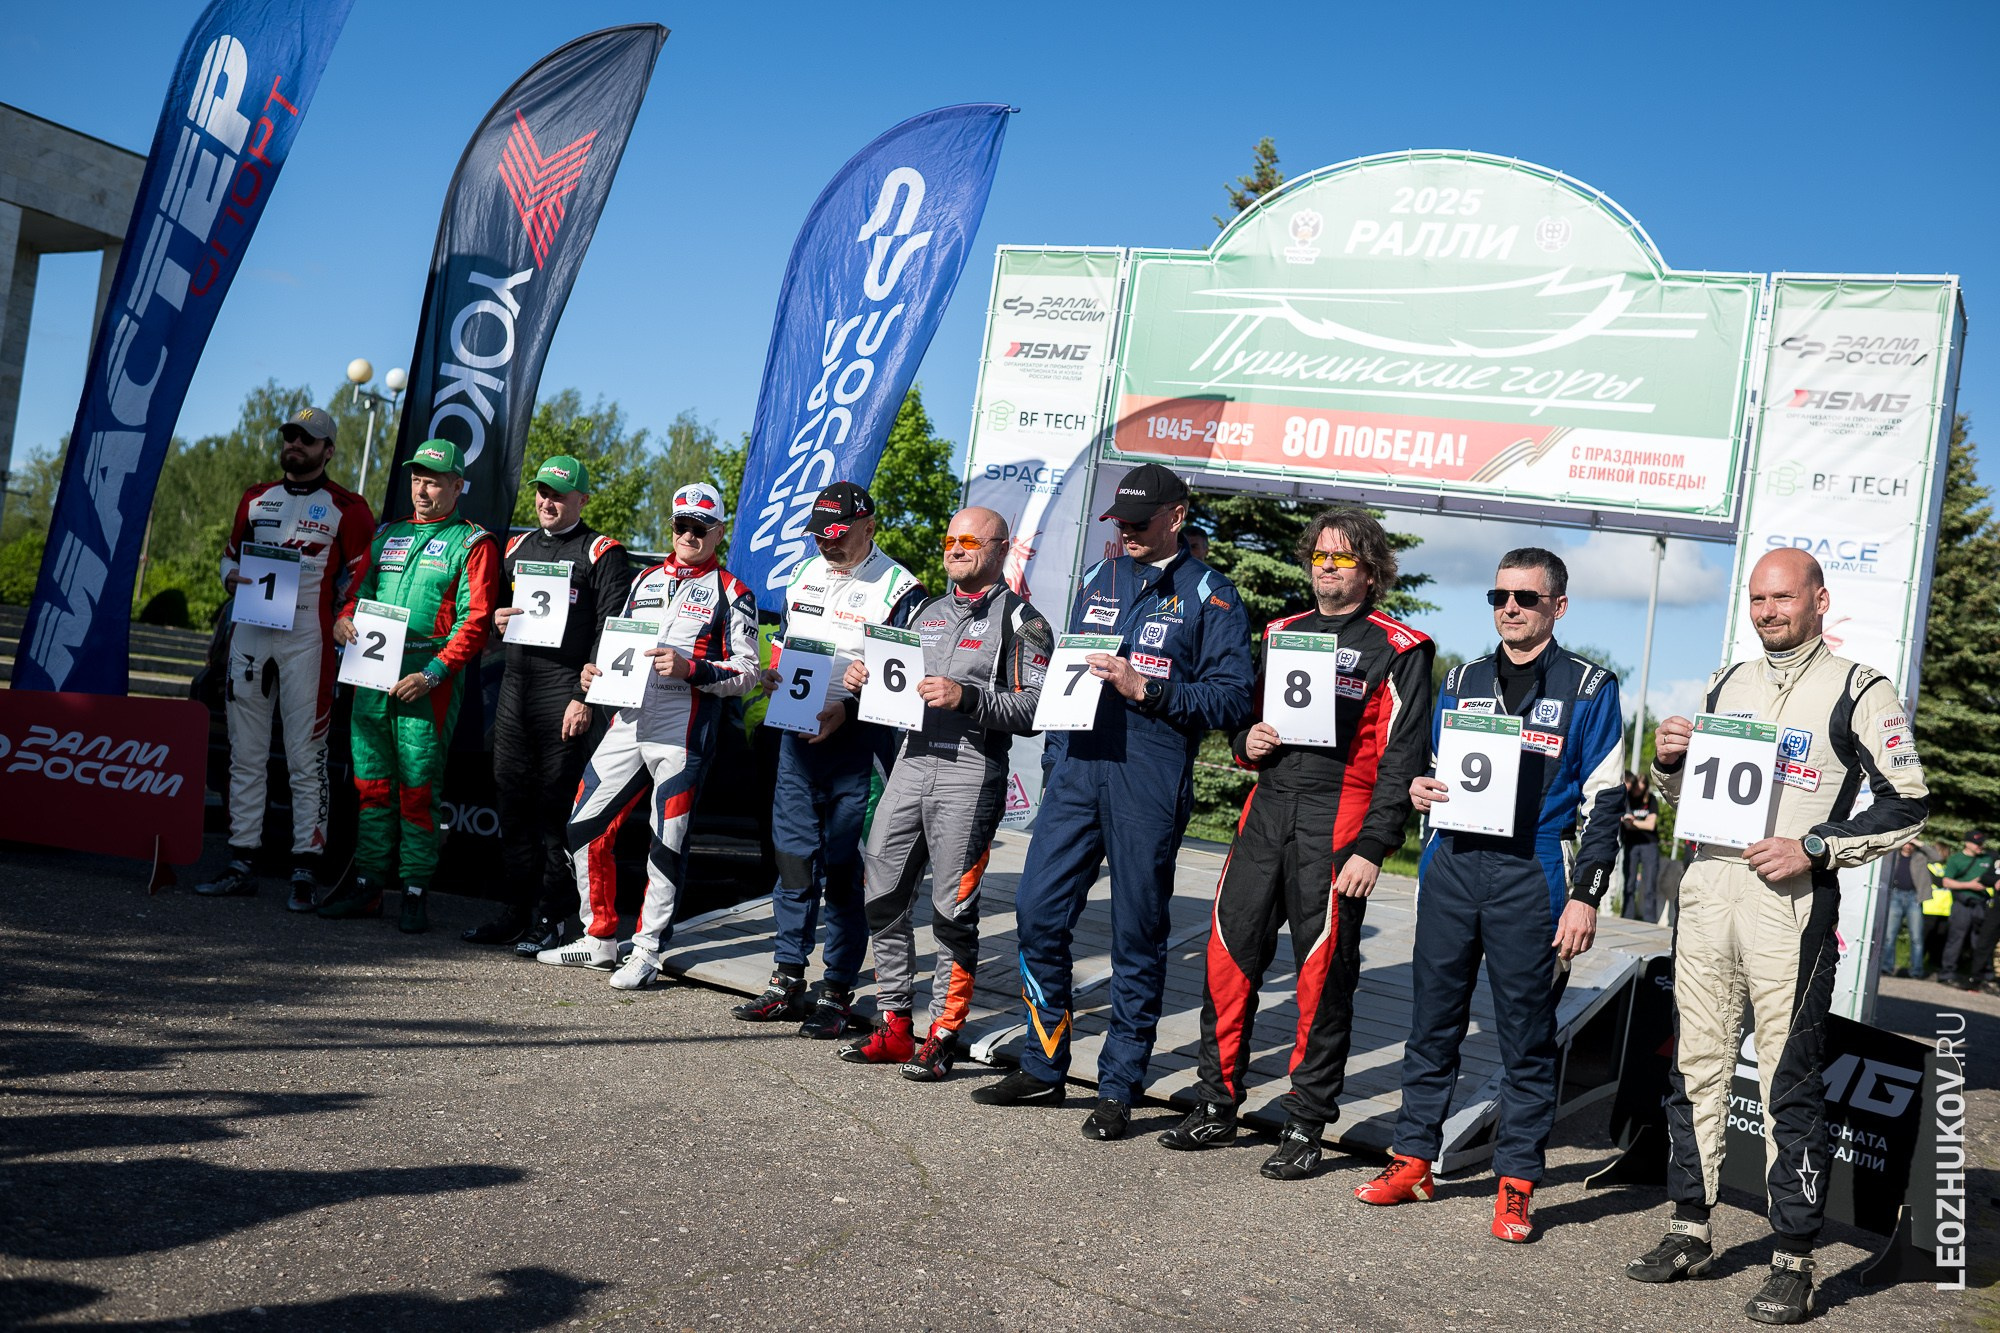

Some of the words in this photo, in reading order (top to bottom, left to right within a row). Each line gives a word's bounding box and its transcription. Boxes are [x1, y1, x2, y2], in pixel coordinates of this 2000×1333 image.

[190, 75, 299, 297] СПОРТ
[1389, 187, 1485, 215] 2025
[1344, 220, 1520, 260] РАЛЛИ
[1033, 309, 1105, 322] РОССИИ
[1038, 296, 1100, 309] РАЛЛИ
[1005, 342, 1091, 361] ASMG
[1831, 335, 1920, 351] РАЛЛИ
[29, 34, 249, 692] МАСТЕР
[1189, 313, 1504, 390] Пушкинские
[1500, 358, 1645, 417] горы
[1825, 350, 1928, 366] РОССИИ
[1788, 389, 1911, 413] ASMG
[1019, 411, 1039, 427] BF
[1044, 413, 1086, 431] TECH
[1281, 415, 1328, 459] 80
[1333, 424, 1469, 469] ПОБЕДА!
[1571, 445, 1581, 460] С
[1586, 447, 1685, 469] ПРАЗДНИКОМ
[984, 463, 1064, 485] SPACE
[1568, 463, 1635, 485] ВЕЛИКОЙ
[1639, 469, 1706, 490] ПОБЕДЫ!
[1813, 473, 1841, 492] BF
[1849, 475, 1909, 497] TECH
[1024, 484, 1061, 495] TRAVEL
[1823, 560, 1877, 574] TRAVEL
[259, 573, 277, 601] 1
[529, 590, 551, 620] 3
[362, 631, 387, 662] 2
[1392, 631, 1413, 649] OMP
[611, 647, 636, 677] 4
[883, 658, 907, 692] 6
[789, 667, 814, 701] 5
[1063, 663, 1091, 696] 7
[1284, 669, 1312, 709] 8
[1585, 668, 1607, 696] sparco
[1461, 700, 1493, 710] ASMG
[21, 725, 170, 768] РАЛЛИ
[7, 751, 184, 798] РОССИИ
[317, 746, 328, 824] YOKOHAMA
[1460, 752, 1493, 793] 9
[1694, 756, 1763, 806] 10
[560, 952, 593, 964] PUMA
[1671, 1222, 1689, 1232] OMP
[1674, 1254, 1688, 1268] OMP
[1775, 1256, 1795, 1267] OMP
